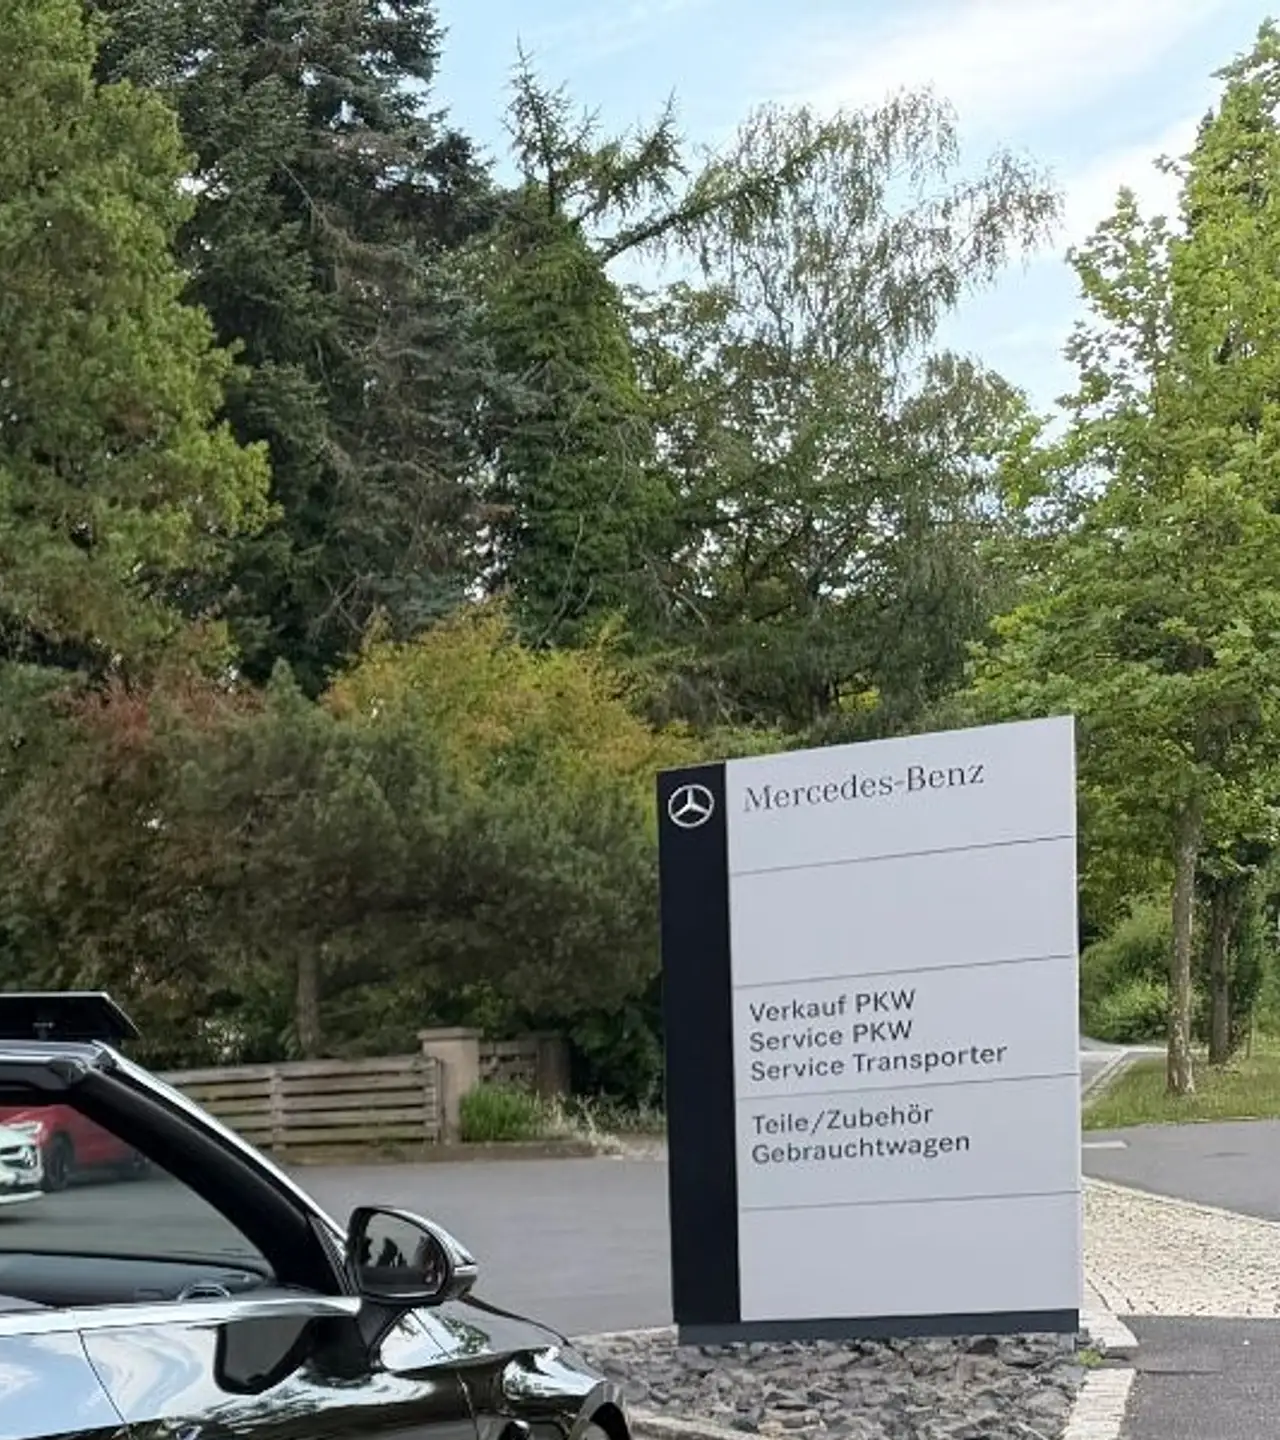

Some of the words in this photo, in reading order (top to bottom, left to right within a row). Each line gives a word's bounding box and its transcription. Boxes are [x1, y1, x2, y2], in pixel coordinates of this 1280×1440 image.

[743, 764, 984, 812] Mercedes-Benz
[749, 993, 847, 1022] Verkauf
[855, 988, 916, 1014] PKW
[749, 1029, 843, 1052] Service
[852, 1020, 913, 1043] PKW
[750, 1057, 844, 1081] Service
[852, 1045, 1008, 1073] Transporter
[752, 1104, 934, 1135] Teile/Zubehör
[752, 1135, 970, 1164] Gebrauchtwagen
